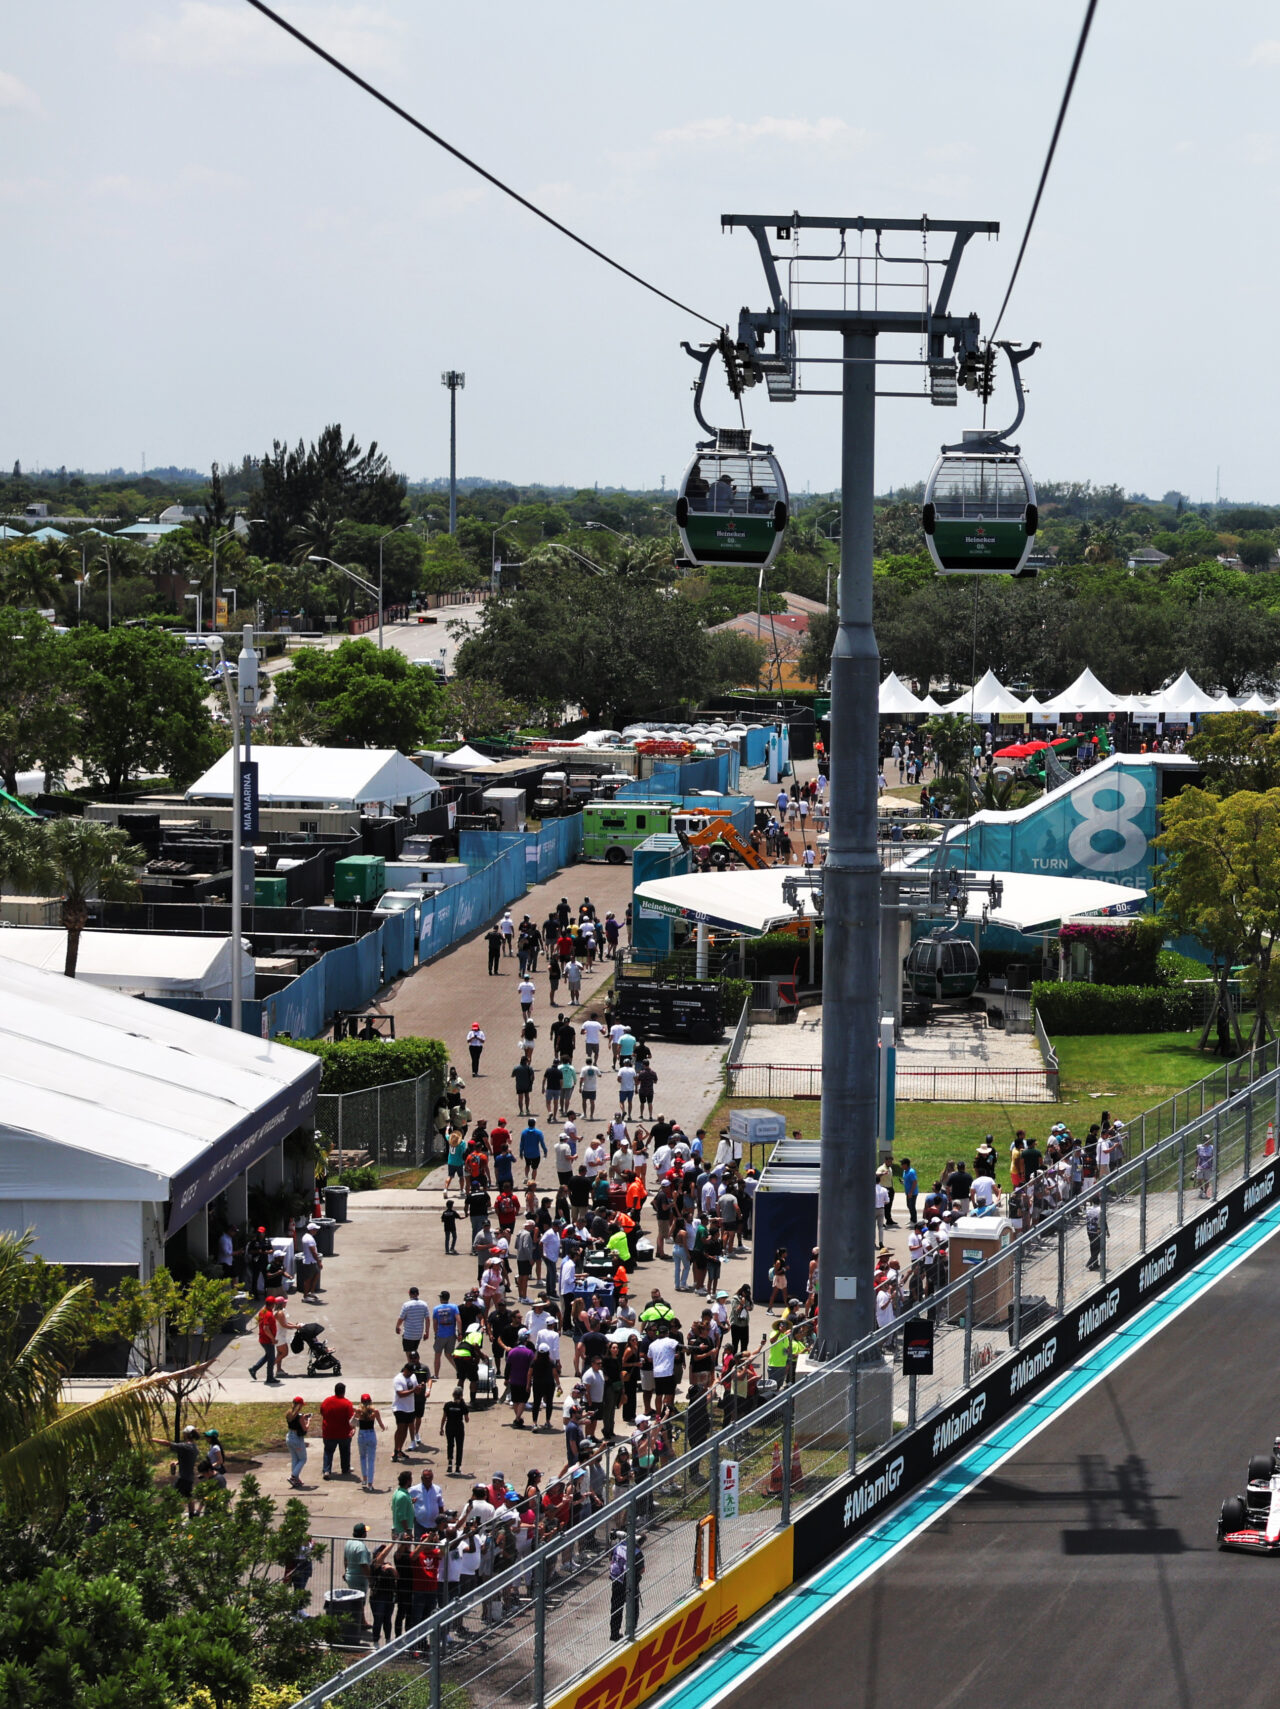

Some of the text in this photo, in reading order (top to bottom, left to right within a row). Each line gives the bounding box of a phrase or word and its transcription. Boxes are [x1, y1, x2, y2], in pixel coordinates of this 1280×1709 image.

[243, 773, 252, 830] MIA MARINA
[1068, 771, 1147, 872] 8
[734, 834, 748, 848] JCB
[1032, 859, 1069, 869] TURN
[642, 900, 677, 913] Heineken
[1243, 1170, 1275, 1213] #MiamiGP
[1194, 1205, 1229, 1250] #MiamiGP
[1139, 1244, 1177, 1294] #MiamiGP
[1078, 1287, 1120, 1342] #MiamiGP
[1010, 1337, 1057, 1396] #MiamiGP
[932, 1392, 987, 1457] #MiamiGP
[843, 1455, 905, 1528] #MiamiGP
[574, 1601, 714, 1709] DHL
